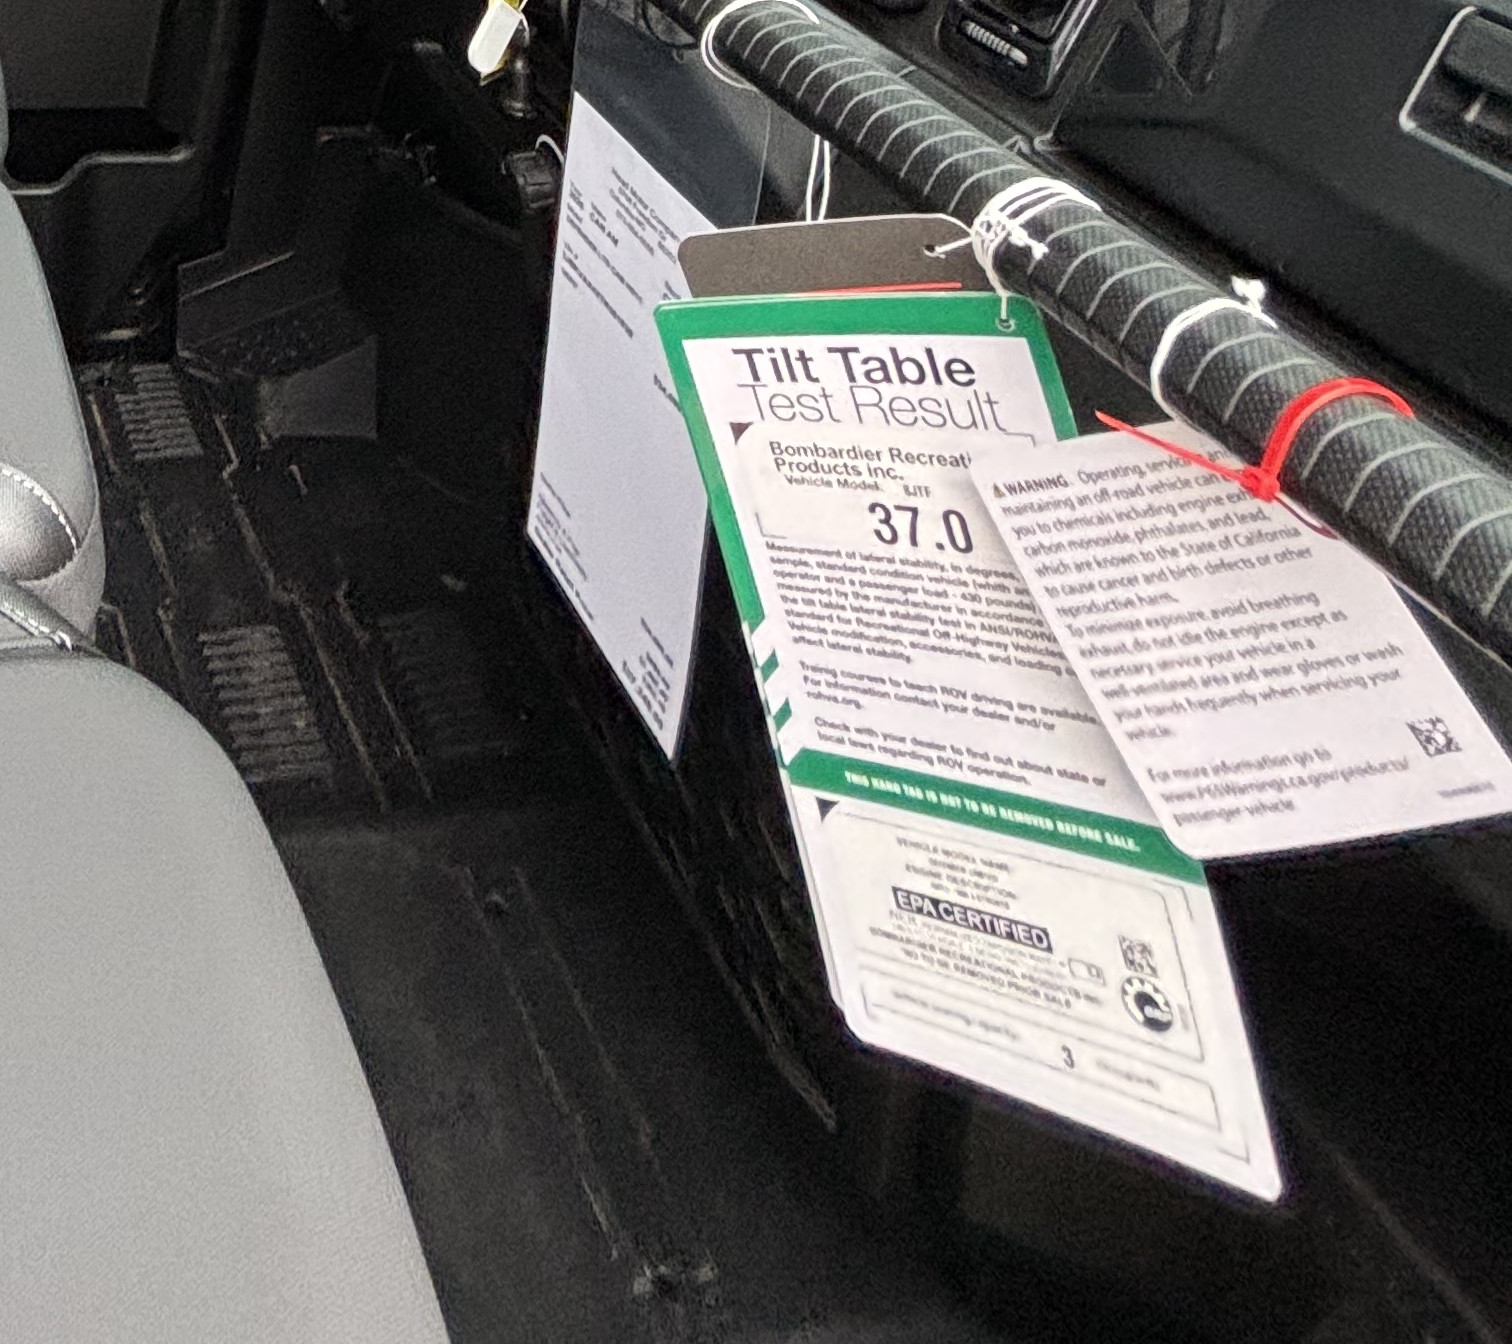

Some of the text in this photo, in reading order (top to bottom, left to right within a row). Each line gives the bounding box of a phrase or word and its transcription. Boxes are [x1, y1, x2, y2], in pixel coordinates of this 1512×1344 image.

[732, 345, 976, 387] Tilt Table
[737, 383, 1007, 433] Test Result
[769, 440, 883, 463] Bombardier
[774, 457, 905, 481] Products Inc.
[785, 473, 834, 490] Vehicle
[868, 501, 974, 555] 37.0
[896, 891, 1047, 947] EPA CERTIFIED
[1061, 1045, 1074, 1068] 3
